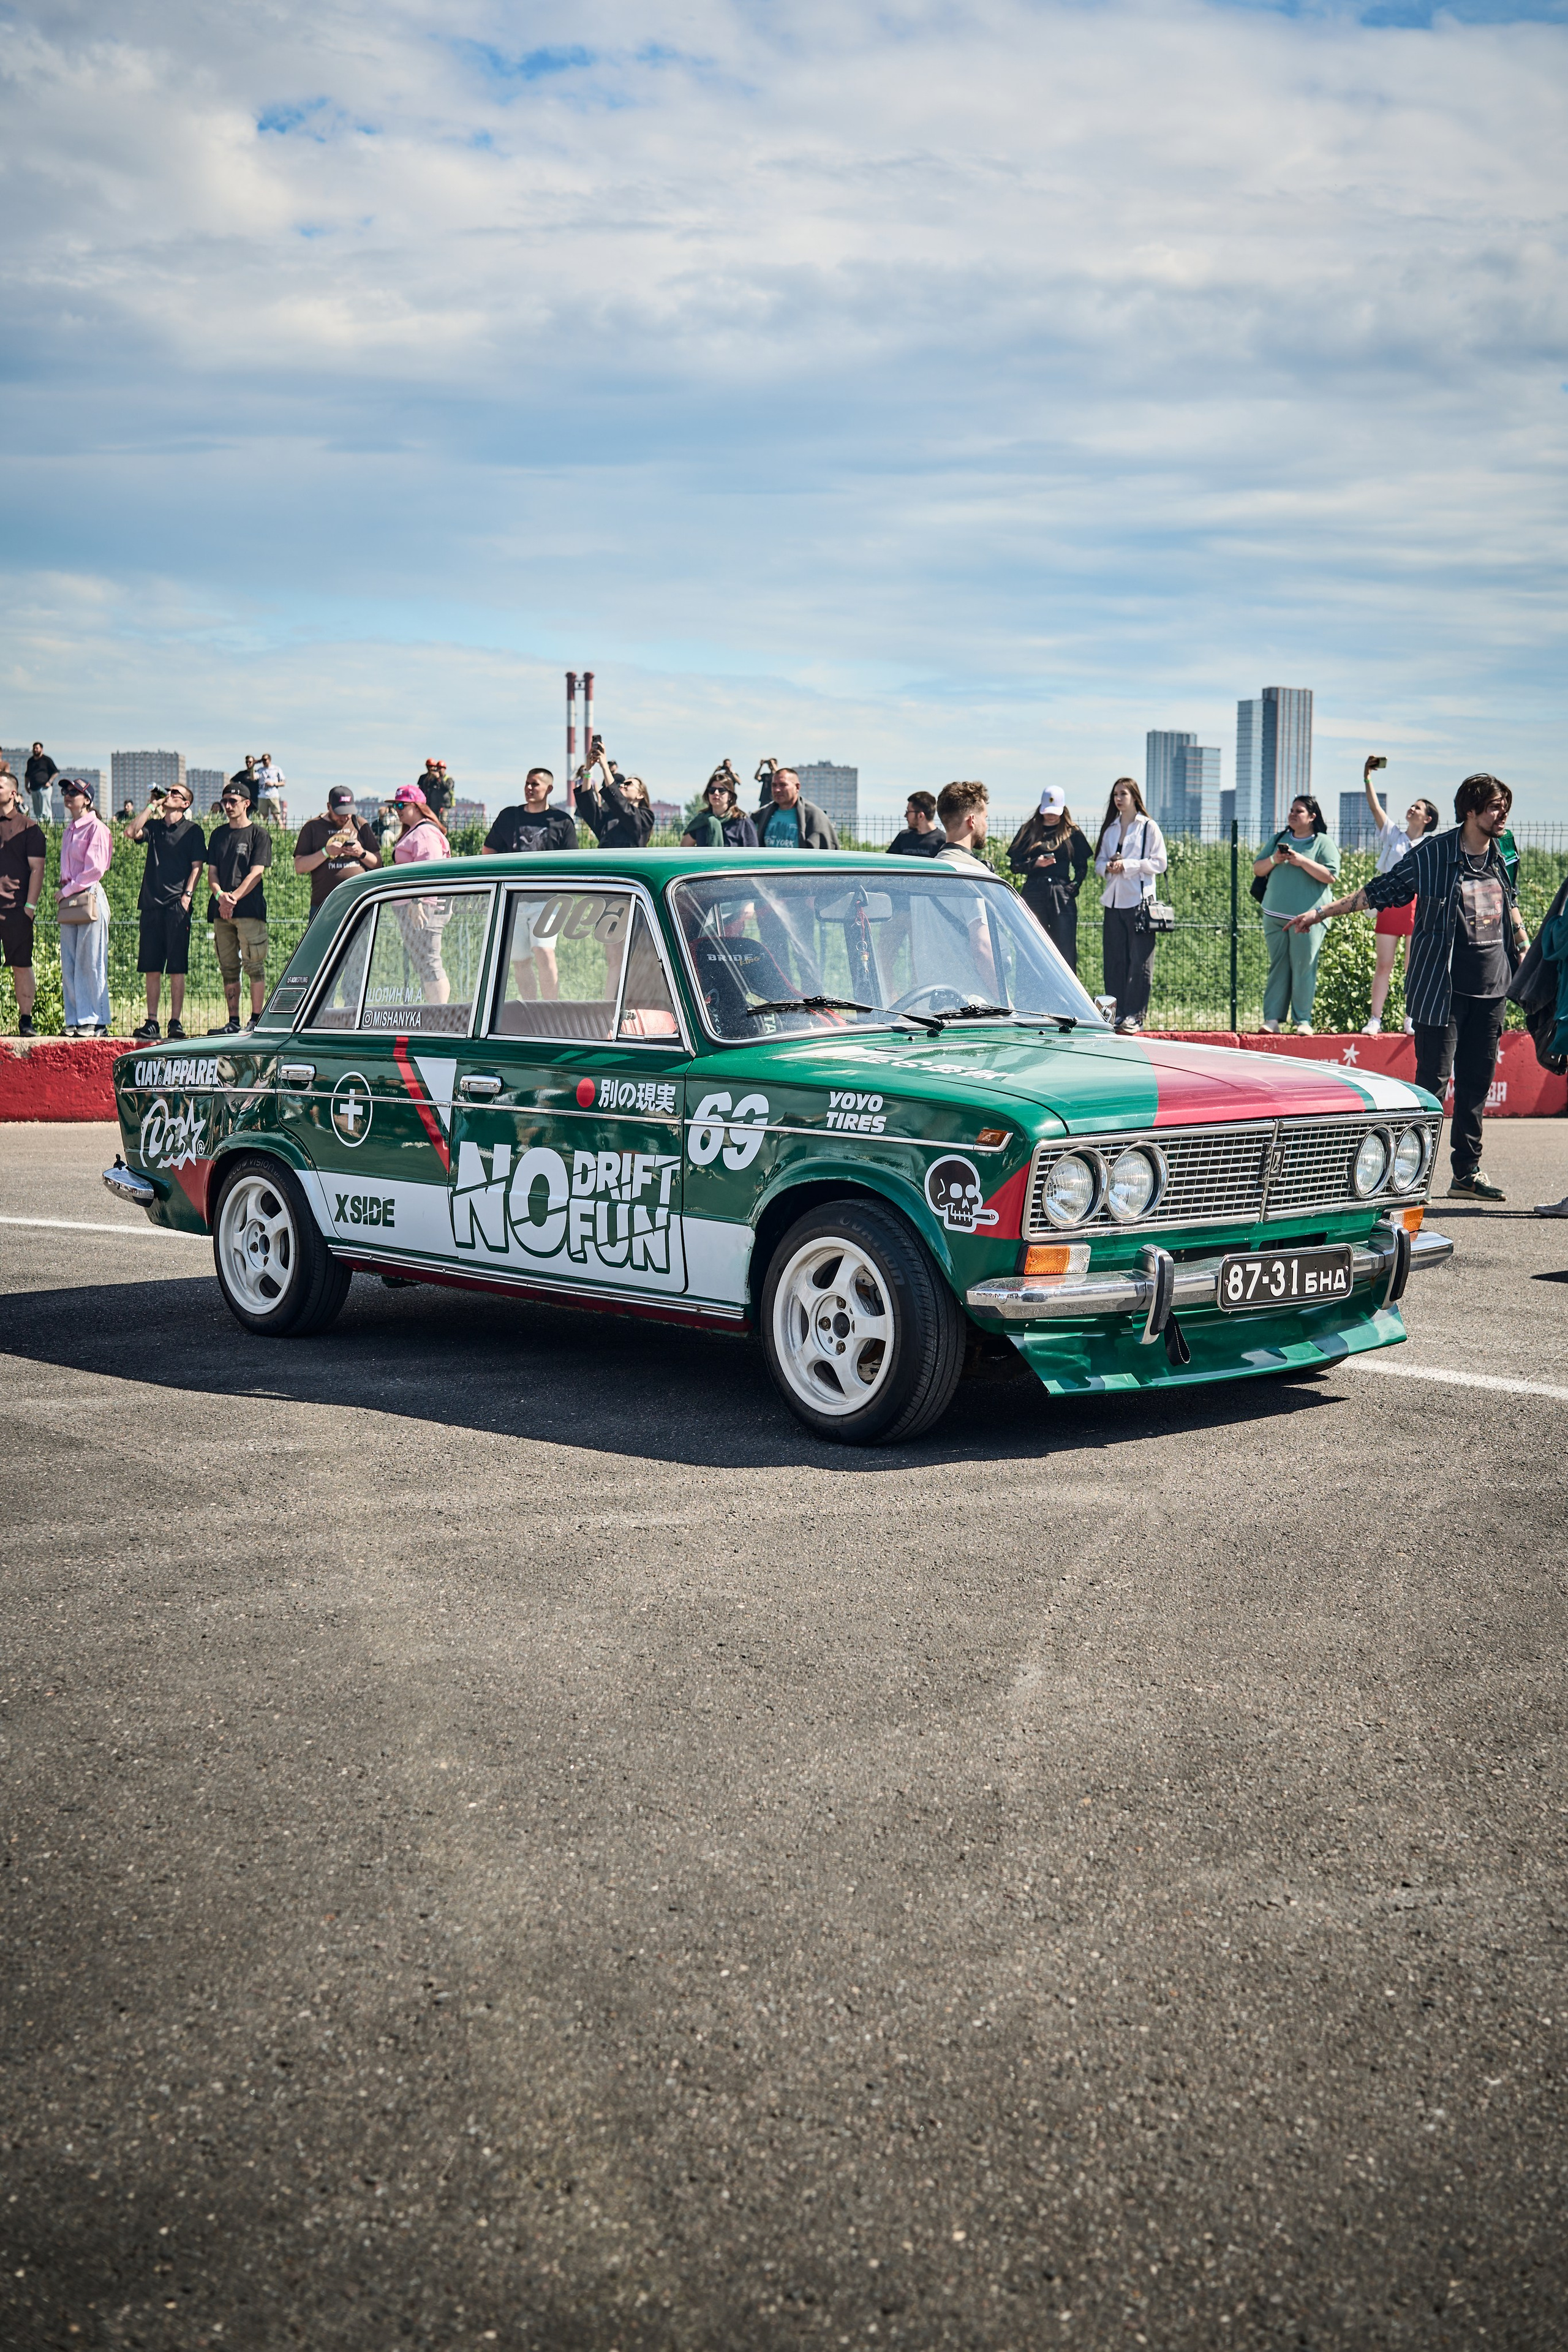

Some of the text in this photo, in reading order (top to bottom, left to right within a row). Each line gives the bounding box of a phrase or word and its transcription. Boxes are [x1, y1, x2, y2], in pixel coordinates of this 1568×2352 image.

[776, 839, 794, 848] YORK
[372, 1011, 421, 1027] MISHANYKA
[162, 1059, 219, 1085] APPAREL
[598, 1079, 676, 1114] 別の現実
[828, 1091, 884, 1112] YOYO
[687, 1091, 769, 1170] 69
[826, 1111, 887, 1133] TIRES
[249, 1158, 275, 1173] VISION
[571, 1150, 682, 1205] DRIFT
[334, 1194, 396, 1227] XSIDE
[453, 1141, 570, 1257] NO
[568, 1198, 669, 1273] FUN
[1227, 1259, 1346, 1301] 87-31 БНД
